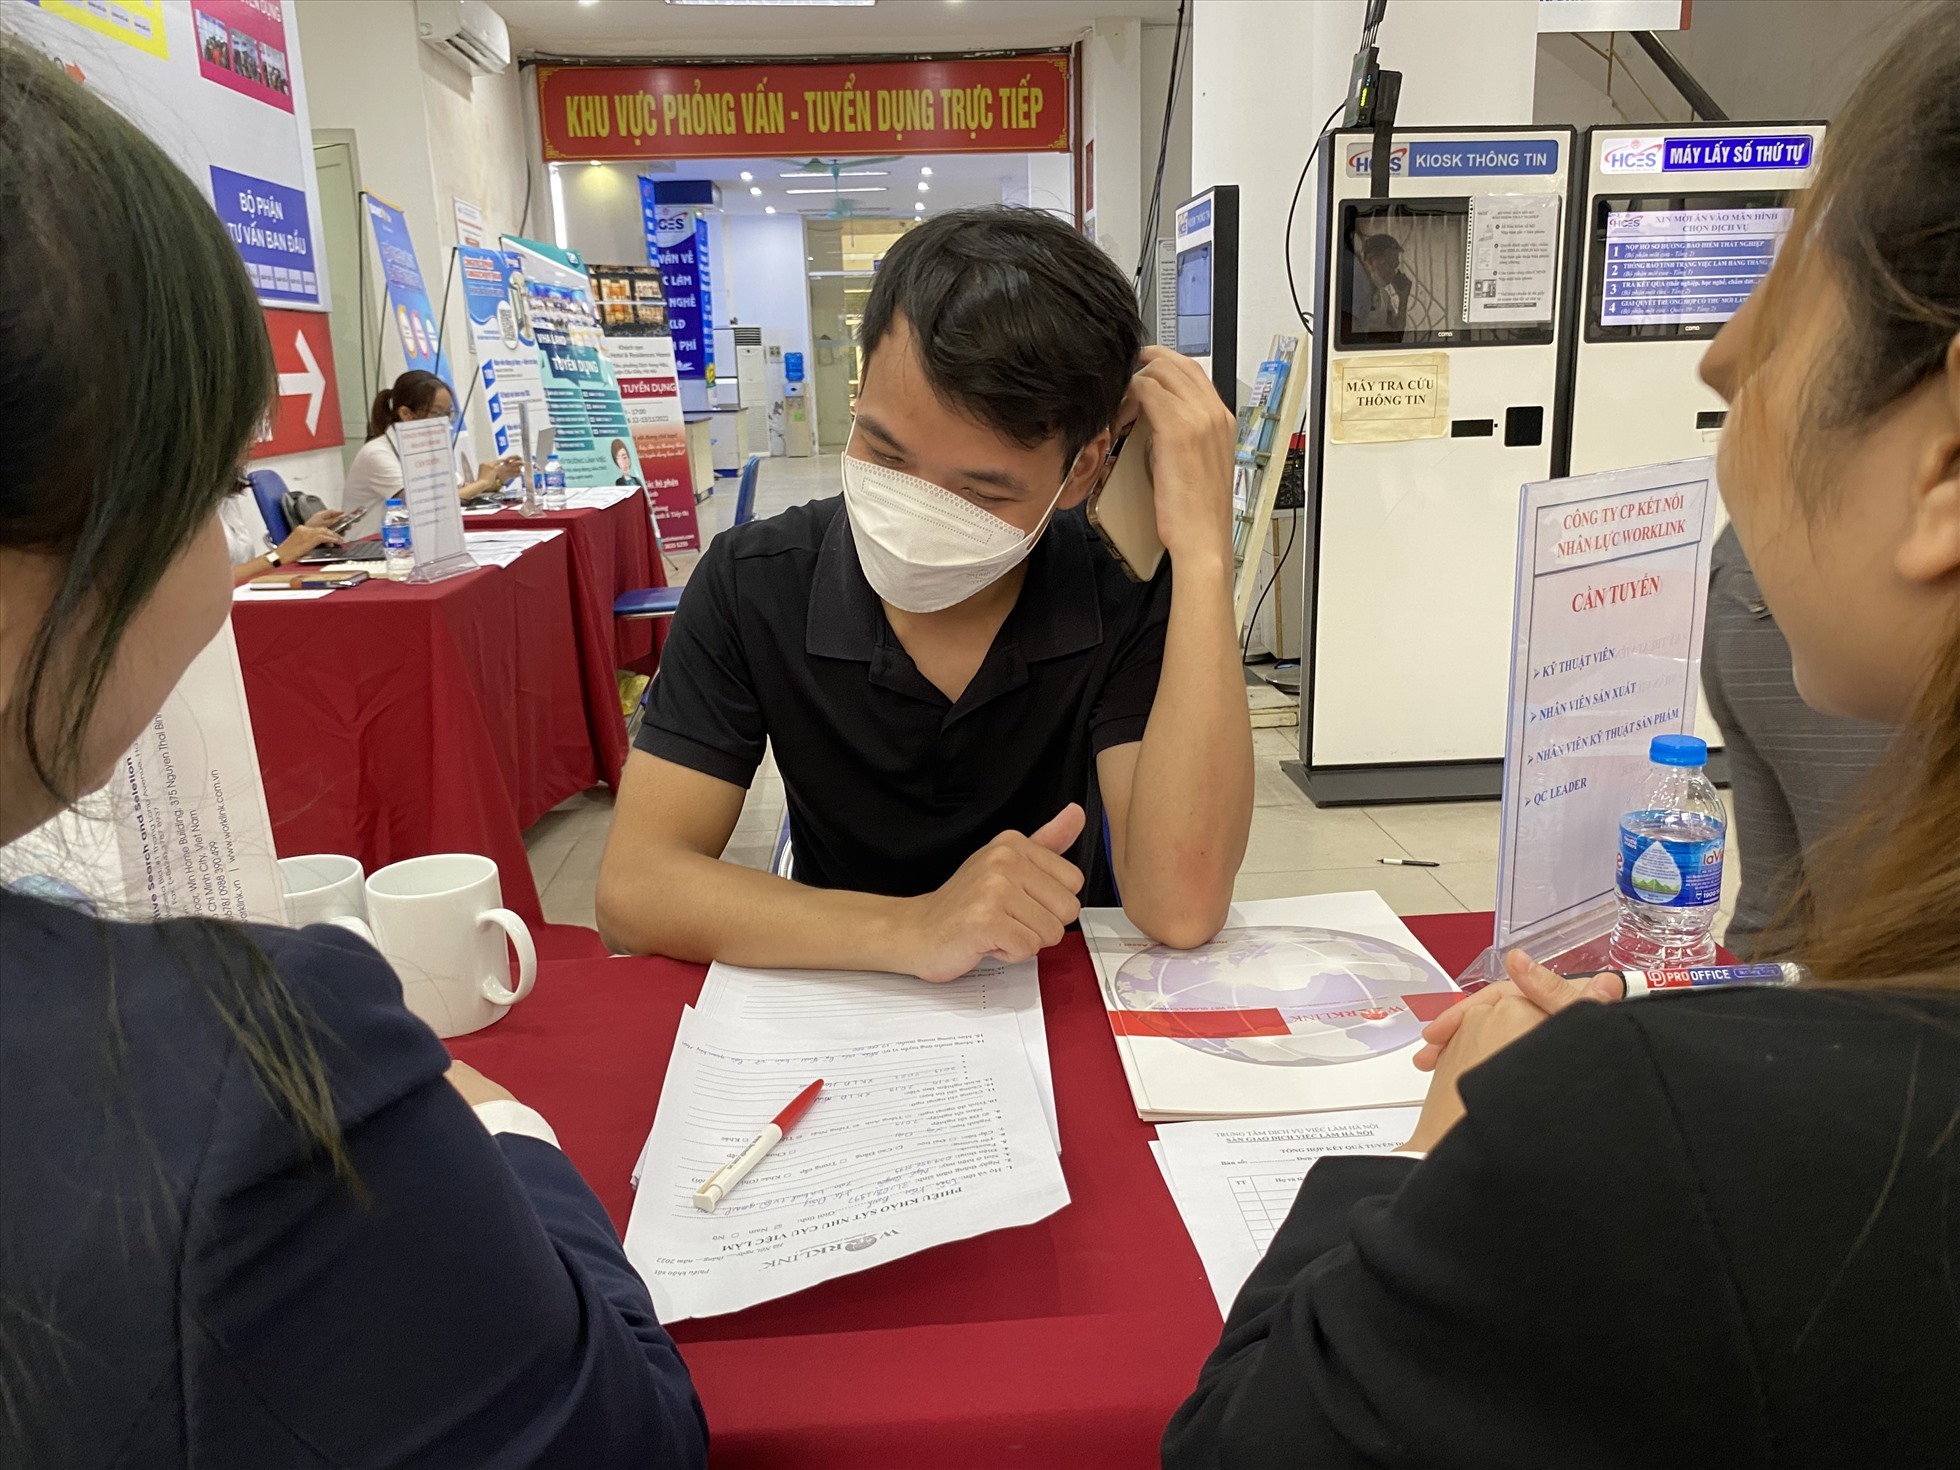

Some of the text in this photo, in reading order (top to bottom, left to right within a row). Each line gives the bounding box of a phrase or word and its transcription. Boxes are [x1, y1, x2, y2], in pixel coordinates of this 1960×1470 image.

[566, 72, 1043, 146] KHU VỰC PHỎNG VẤN - TUYỂN DỤNG TRỰC TIẾP
[1416, 150, 1547, 168] KIOSK THÔNG TIN
[1611, 152, 1657, 168] HCES
[1670, 140, 1805, 165] MÁY LẤY SỐ THỨ TỰ
[1356, 156, 1402, 172] HS
[239, 189, 284, 223] BỘ PHẬN
[1656, 215, 1671, 223] XIN
[1673, 214, 1692, 223] MỜI
[1710, 213, 1729, 222] VÀO
[1754, 211, 1778, 220] HÌNH
[1683, 222, 1750, 233] CHỌN DỊCH VỤ
[243, 221, 265, 248] VẤN
[267, 231, 287, 250] BAN
[287, 231, 306, 255] ĐẦU
[1626, 243, 1640, 251] NỘP
[1740, 240, 1764, 248] NGHIỆP
[681, 249, 695, 264] VỀ
[1614, 246, 1619, 257] 1
[1611, 265, 1618, 276] 2
[1676, 261, 1696, 270] TRẠNG
[1698, 260, 1712, 268] VIỆC
[671, 274, 692, 286] LÀM
[1610, 284, 1617, 294] 3
[669, 294, 697, 308] NGHỀ
[1609, 302, 1616, 313] 4
[679, 339, 697, 351] PHÍ
[622, 380, 676, 395] TUYỂN DỤNG
[1346, 377, 1434, 392] MÁY TRA CỨU
[1356, 393, 1426, 406] THÔNG TIN
[1563, 494, 1685, 530] CÔNG TY CP KẾT NỐI
[1557, 519, 1686, 559] NHÂN LỰC WORKLINK
[1571, 575, 1661, 614] CẦN TUYỂN
[1542, 646, 1615, 679] KỸ THUẬT VIÊN
[1539, 682, 1637, 721] NHÂN VIÊN SẢN XUẤT
[156, 731, 167, 751] Thai
[1536, 708, 1680, 765] NHÂN VIÊN KỸ THUẬT SẢN PHẨM
[161, 752, 177, 788] Nguyen
[170, 789, 181, 806] 375
[1533, 777, 1587, 807] QC LEADER
[126, 757, 155, 891] Search and Seletion
[210, 769, 236, 863] www.worklink.com.vn
[174, 808, 188, 845] Building,
[181, 846, 193, 873] Home
[189, 810, 217, 912] Chi Minh City, Viet Nam
[208, 841, 228, 895] 0988 390 499
[187, 874, 198, 891] Win
[1666, 971, 1690, 982] PRO
[1691, 969, 1731, 981] OFFICE
[1290, 1006, 1404, 1022] WORKLINK
[1215, 1130, 1246, 1138] TRUNG
[1247, 1129, 1266, 1137] TÂM
[1268, 1128, 1290, 1136] DỊCH
[1291, 1127, 1304, 1135] VỤ
[1305, 1125, 1326, 1134] VIỆC
[1349, 1123, 1361, 1131] HÀ
[1363, 1123, 1379, 1131] NỘI
[1245, 1135, 1269, 1143] GIAO
[1271, 1134, 1293, 1142] DỊCH
[1295, 1133, 1317, 1141] VIỆC
[1319, 1131, 1338, 1139] LÀM
[1339, 1130, 1353, 1138] HÀ
[1354, 1129, 1375, 1137] NỘI
[1281, 1141, 1394, 1154] TỔNG HỢP KẾT QUẢ TUYỂN
[722, 1187, 962, 1252] PHIẾU KHẢO SÁT NHU CẦU VIỆC LÀM
[762, 1229, 899, 1269] WORKLINK
